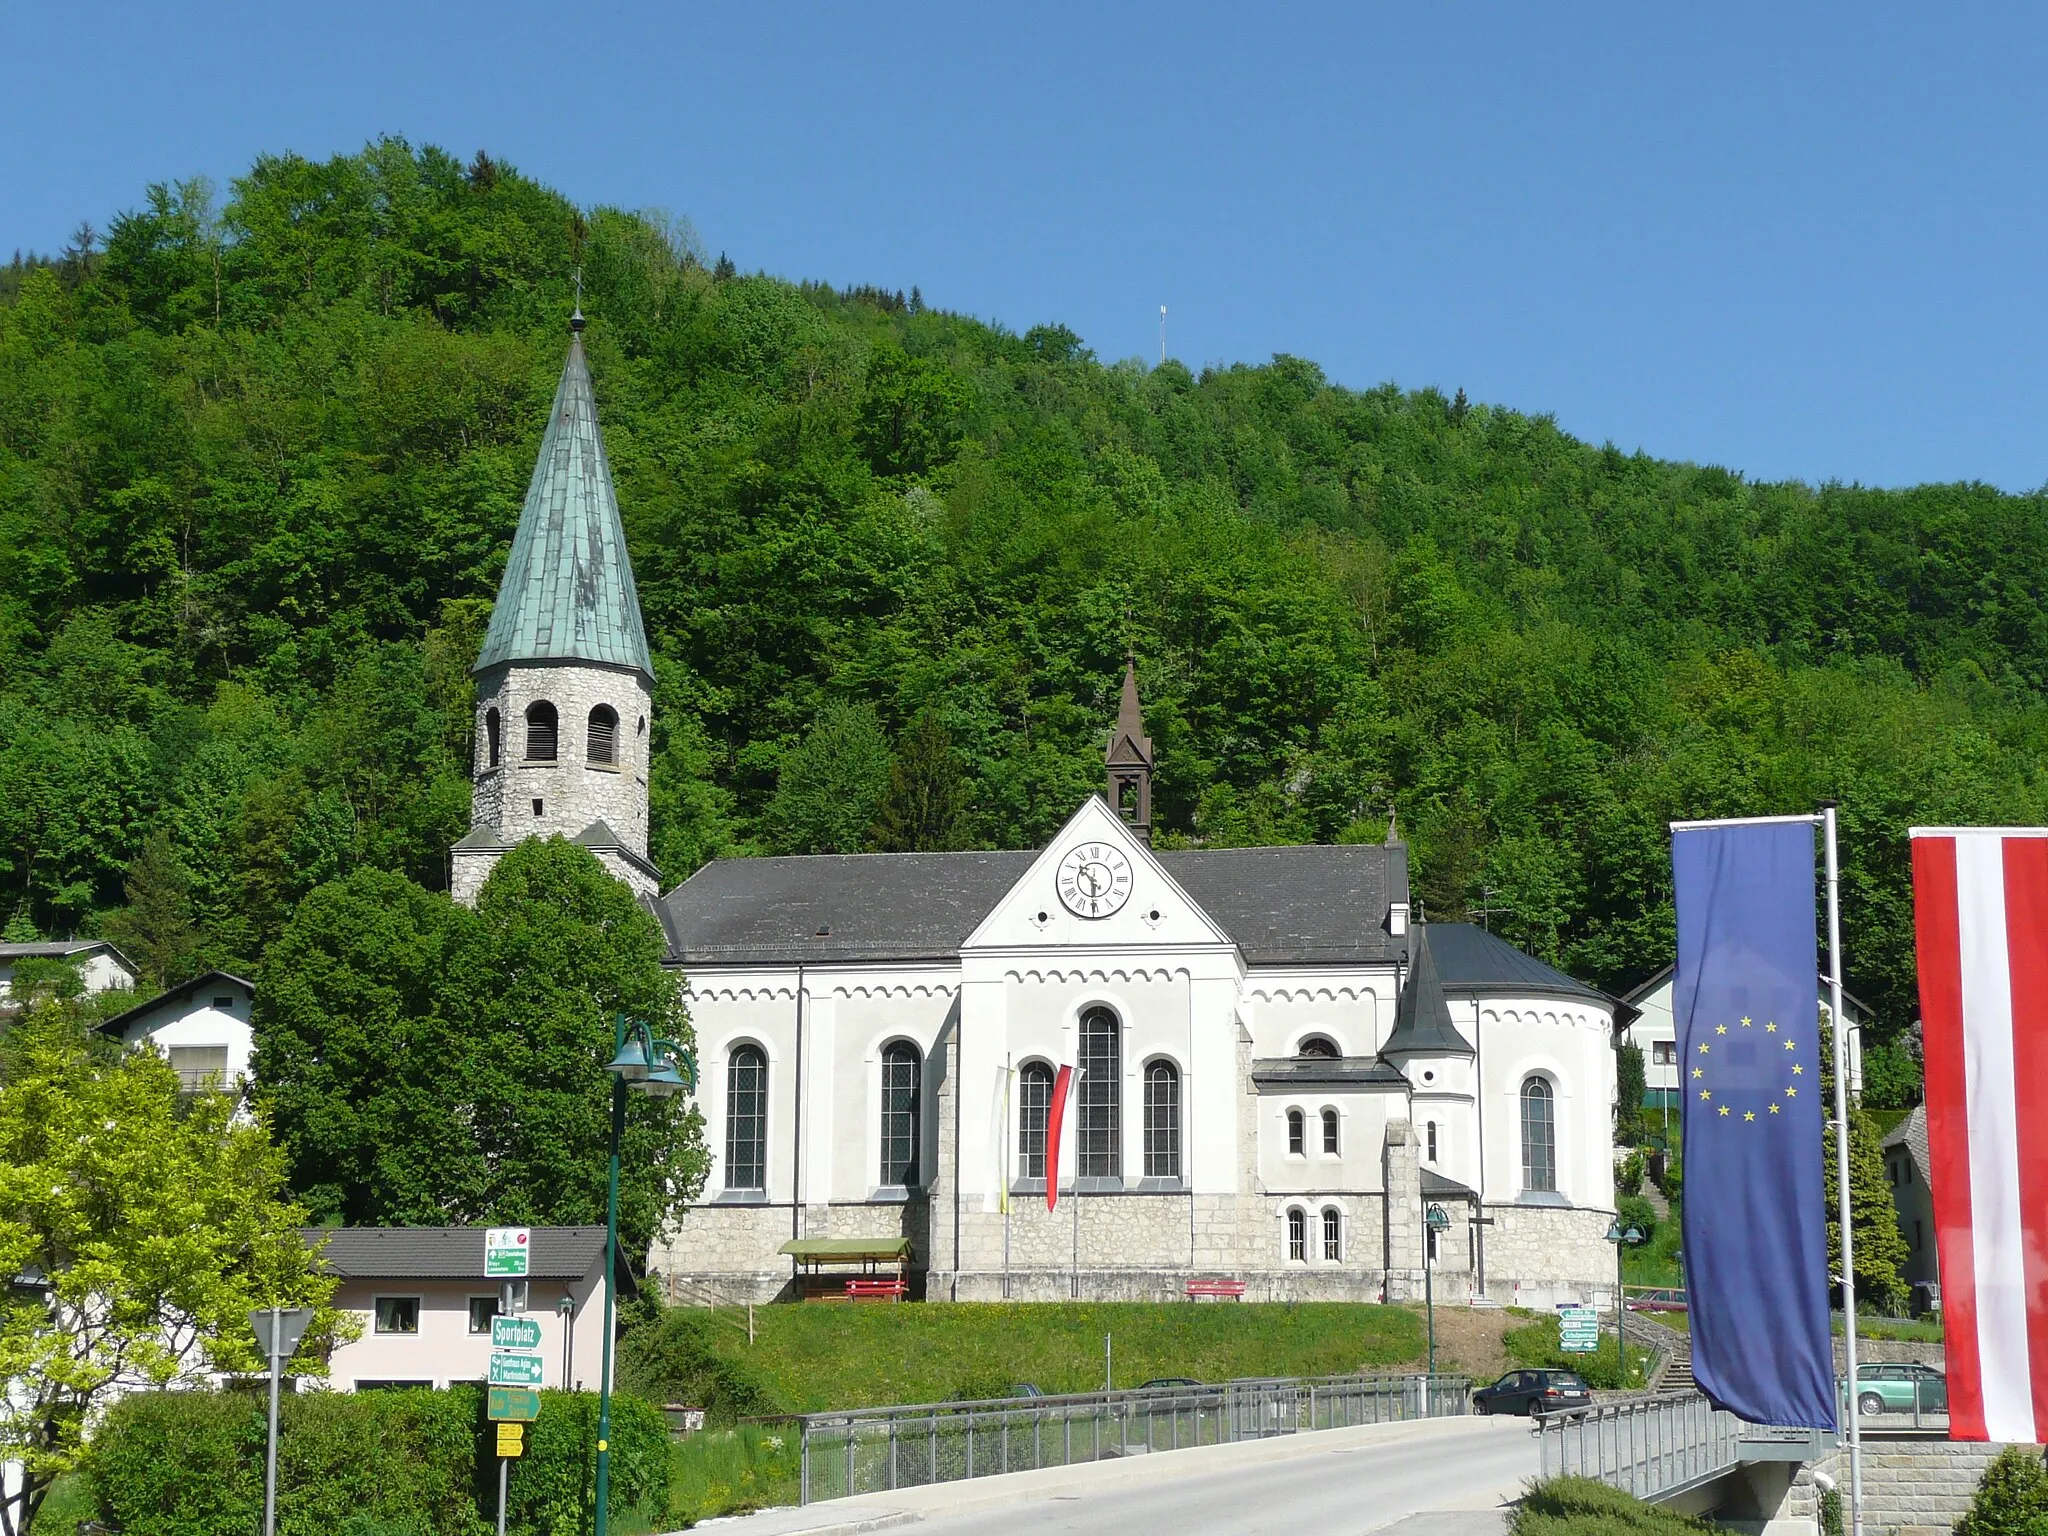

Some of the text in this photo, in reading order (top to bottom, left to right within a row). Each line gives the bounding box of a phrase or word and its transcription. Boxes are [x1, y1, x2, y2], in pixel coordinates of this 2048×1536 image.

[1090, 847, 1099, 858] XII
[1113, 861, 1124, 870] II
[496, 1321, 535, 1346] Sportplatz
